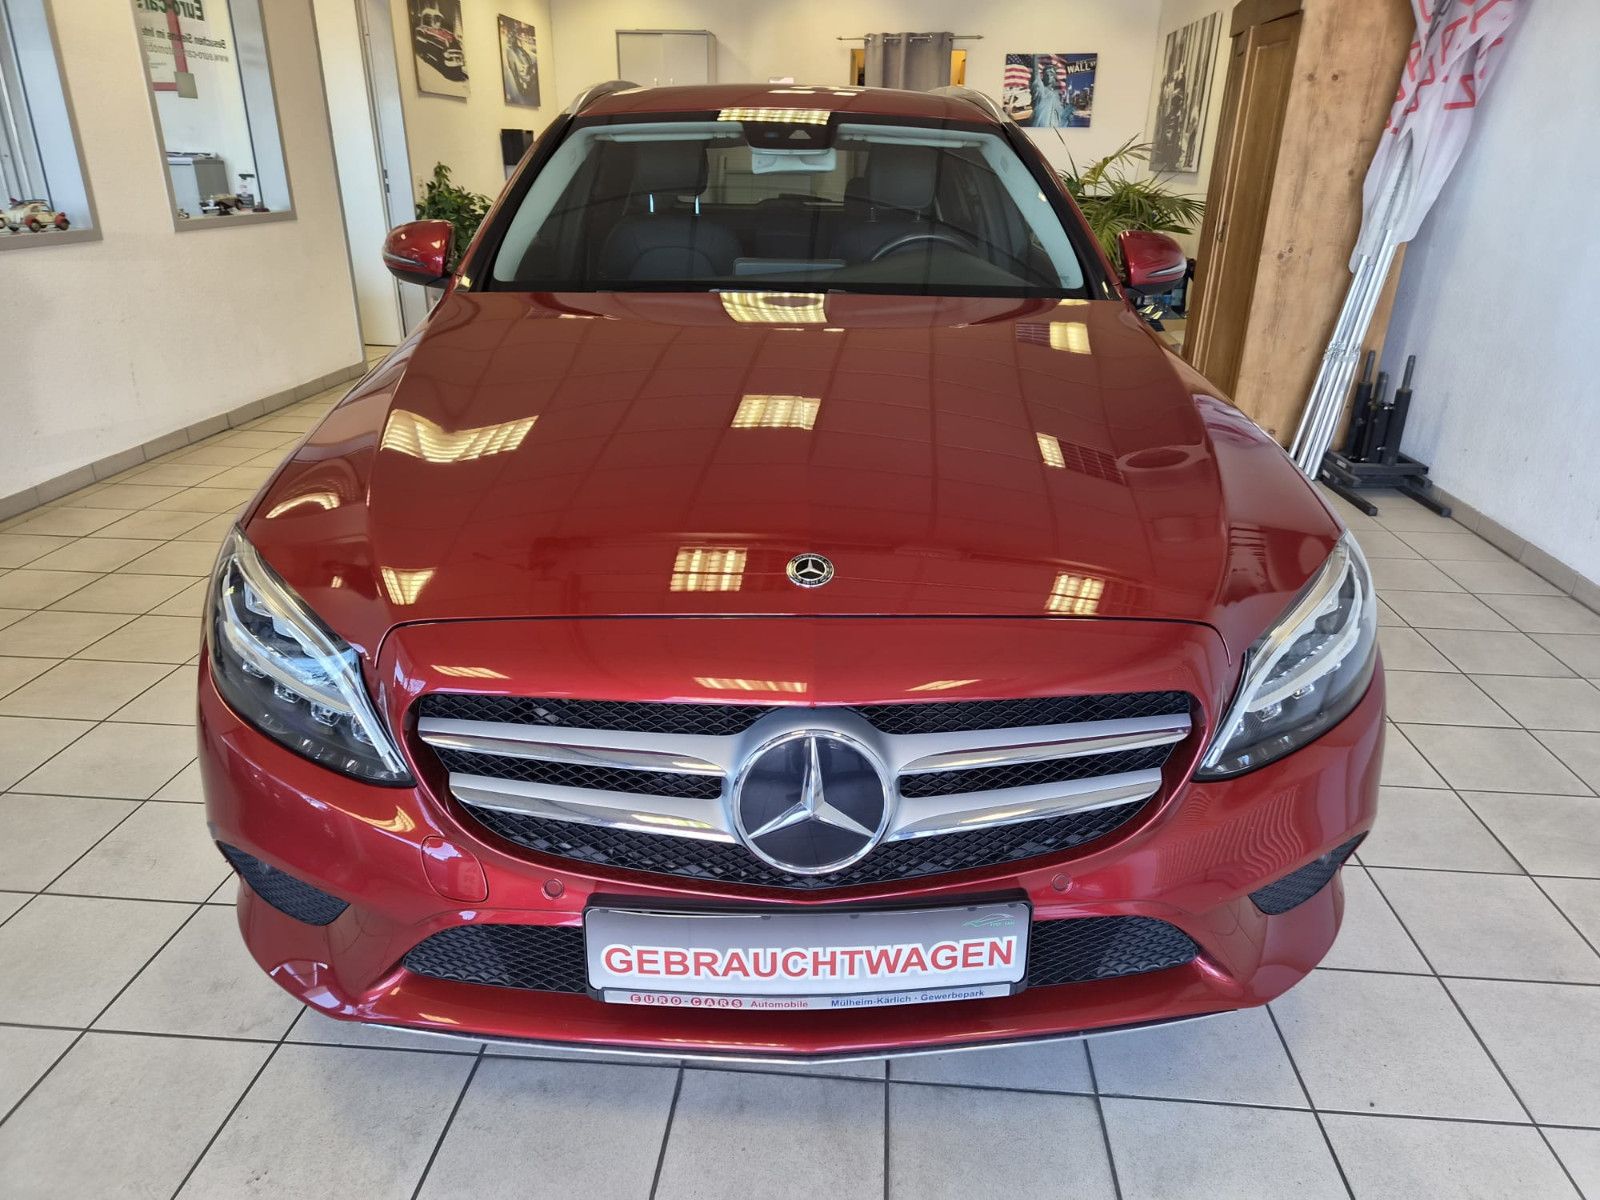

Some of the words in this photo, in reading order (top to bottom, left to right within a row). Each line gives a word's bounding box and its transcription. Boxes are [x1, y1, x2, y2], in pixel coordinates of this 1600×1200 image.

[1067, 62, 1091, 74] WALL
[603, 938, 1014, 978] GEBRAUCHTWAGEN
[630, 993, 743, 1009] EURO-CARS
[750, 1000, 809, 1009] Automobile
[831, 995, 912, 1008] Mülheim-Kärlich
[920, 989, 985, 1002] Gewerbepark
